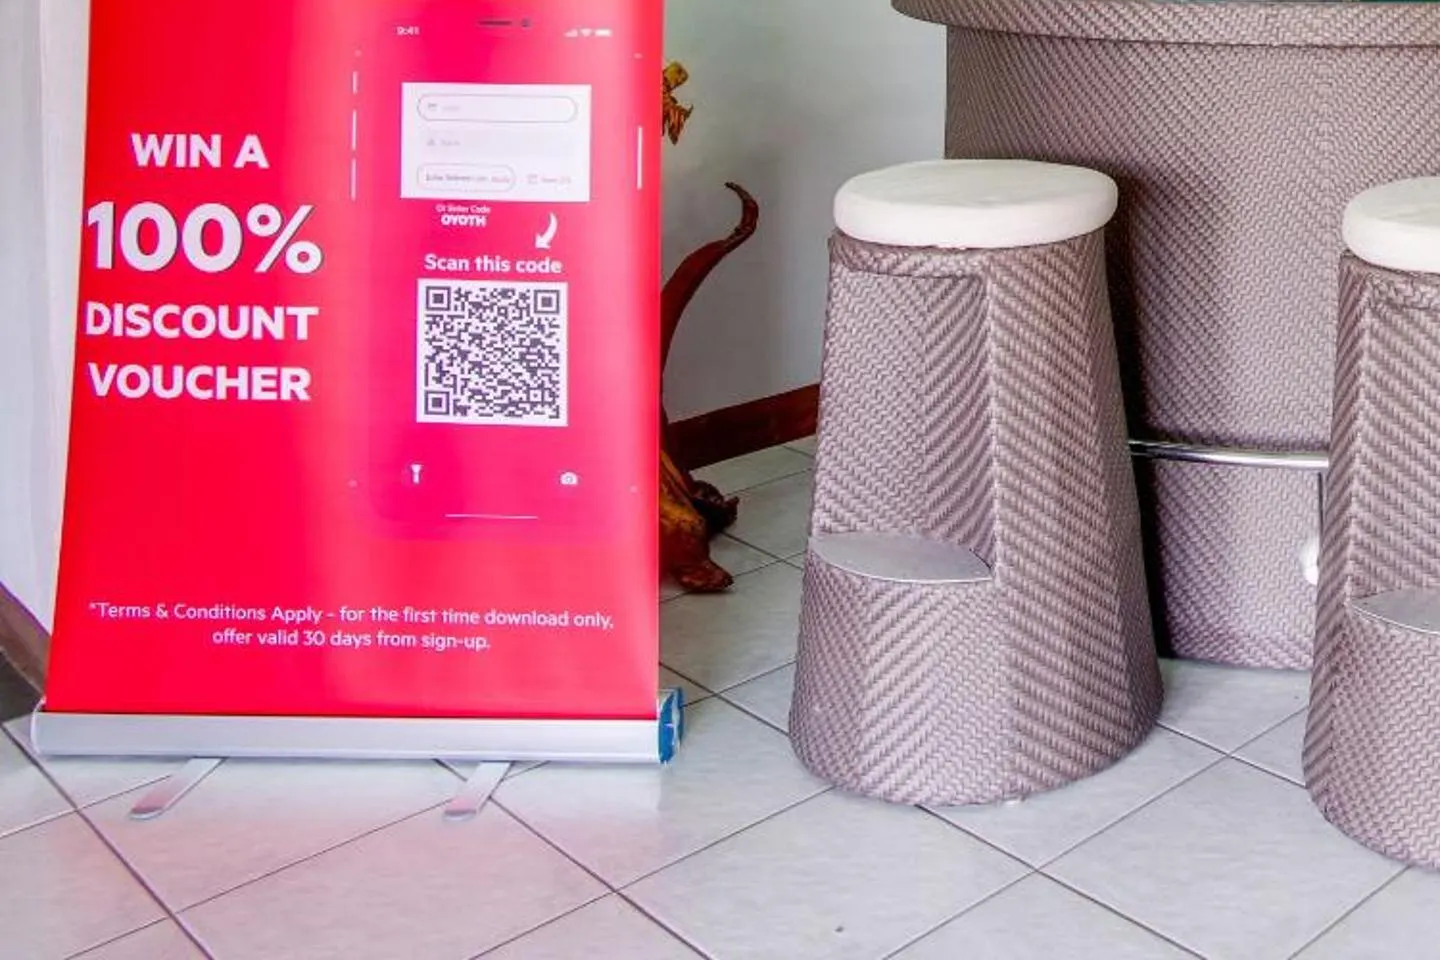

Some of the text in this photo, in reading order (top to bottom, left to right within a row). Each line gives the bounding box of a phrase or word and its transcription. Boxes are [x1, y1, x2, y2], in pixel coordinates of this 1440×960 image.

[131, 134, 270, 168] WIN A
[441, 214, 487, 227] OYOTH
[87, 202, 323, 274] 100%
[424, 253, 563, 274] Scan this code
[86, 304, 320, 341] DISCOUNT
[88, 363, 312, 401] VOUCHER
[155, 604, 168, 619] &
[173, 604, 267, 621] Conditions
[271, 606, 323, 625] Apply
[340, 606, 365, 621] for
[369, 606, 398, 622] the
[402, 607, 436, 624] first
[441, 608, 481, 625] time
[484, 609, 569, 627] download
[212, 628, 491, 652] offer valid 30 days from sign-up.
